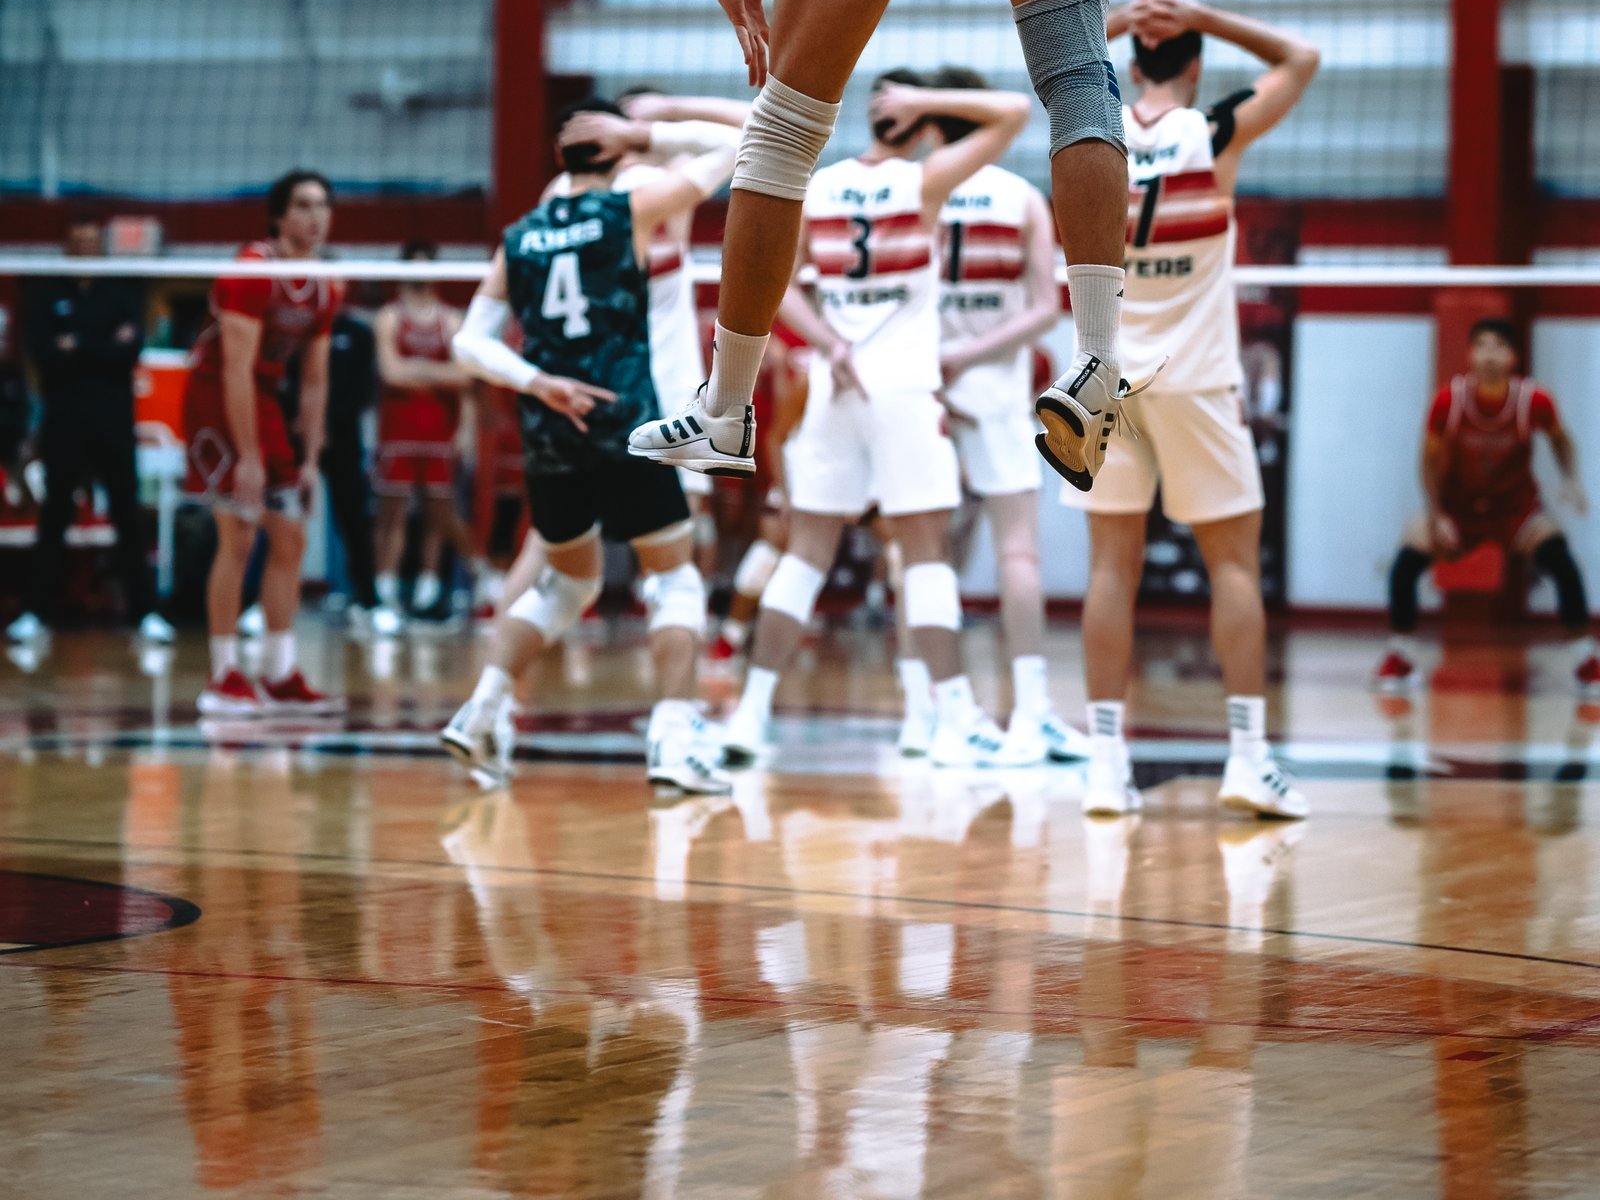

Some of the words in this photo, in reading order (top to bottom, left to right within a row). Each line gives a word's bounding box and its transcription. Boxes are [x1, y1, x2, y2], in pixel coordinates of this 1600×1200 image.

[847, 215, 870, 279] 3
[1134, 174, 1161, 248] 7
[541, 251, 591, 339] 4
